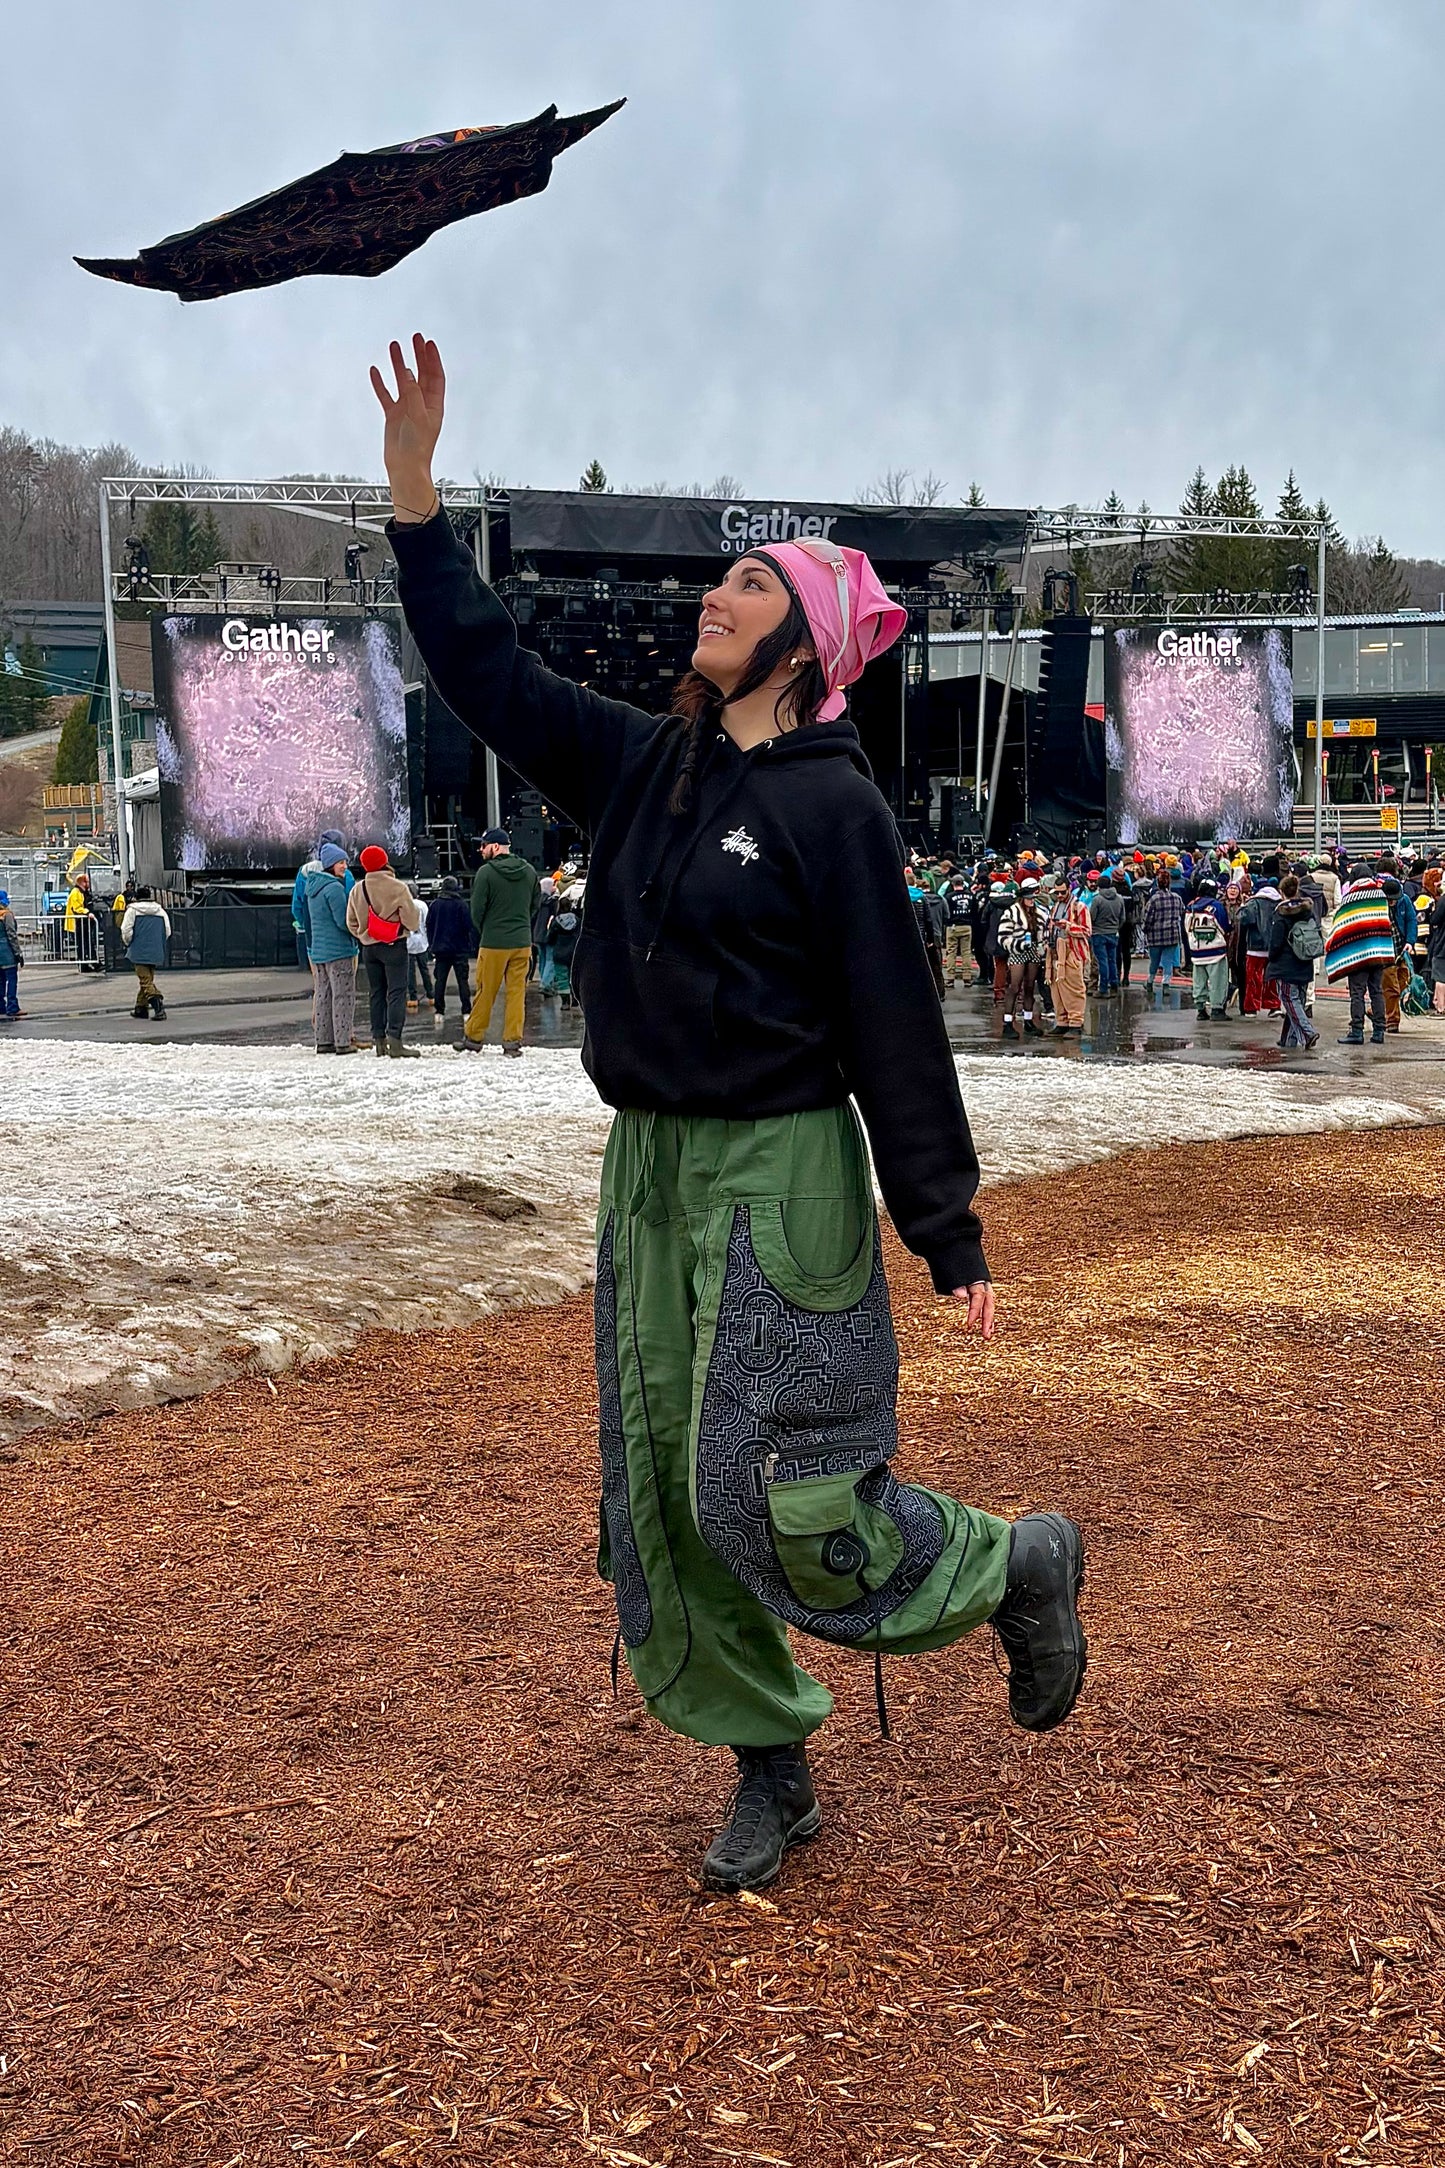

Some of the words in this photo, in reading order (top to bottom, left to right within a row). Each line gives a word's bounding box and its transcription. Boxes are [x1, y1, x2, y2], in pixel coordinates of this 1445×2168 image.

[720, 505, 838, 540] Gather
[221, 620, 335, 652] Gather
[1157, 630, 1243, 657] Gather
[223, 651, 336, 664] OUTDOORS
[1157, 656, 1242, 667] OUTDOORS
